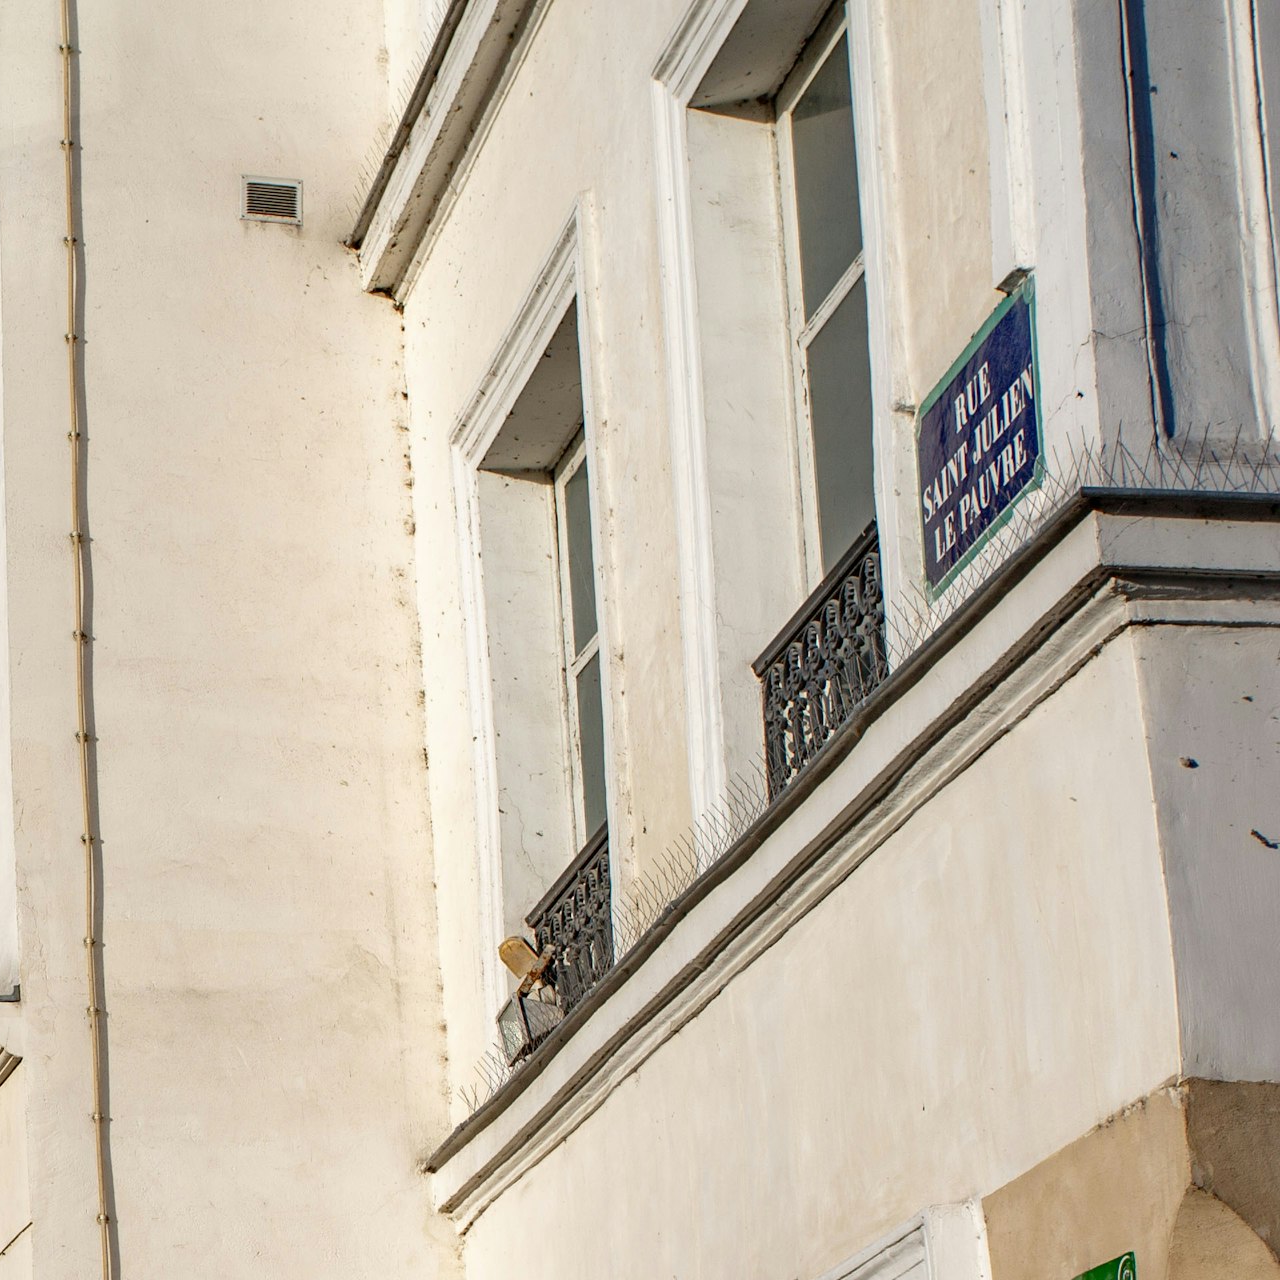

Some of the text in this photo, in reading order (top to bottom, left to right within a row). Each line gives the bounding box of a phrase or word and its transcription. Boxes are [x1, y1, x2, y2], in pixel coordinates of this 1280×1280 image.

[923, 363, 1035, 525] SAINT JULIEN
[954, 361, 991, 434] RUE
[933, 428, 1027, 564] LE PAUVRE
